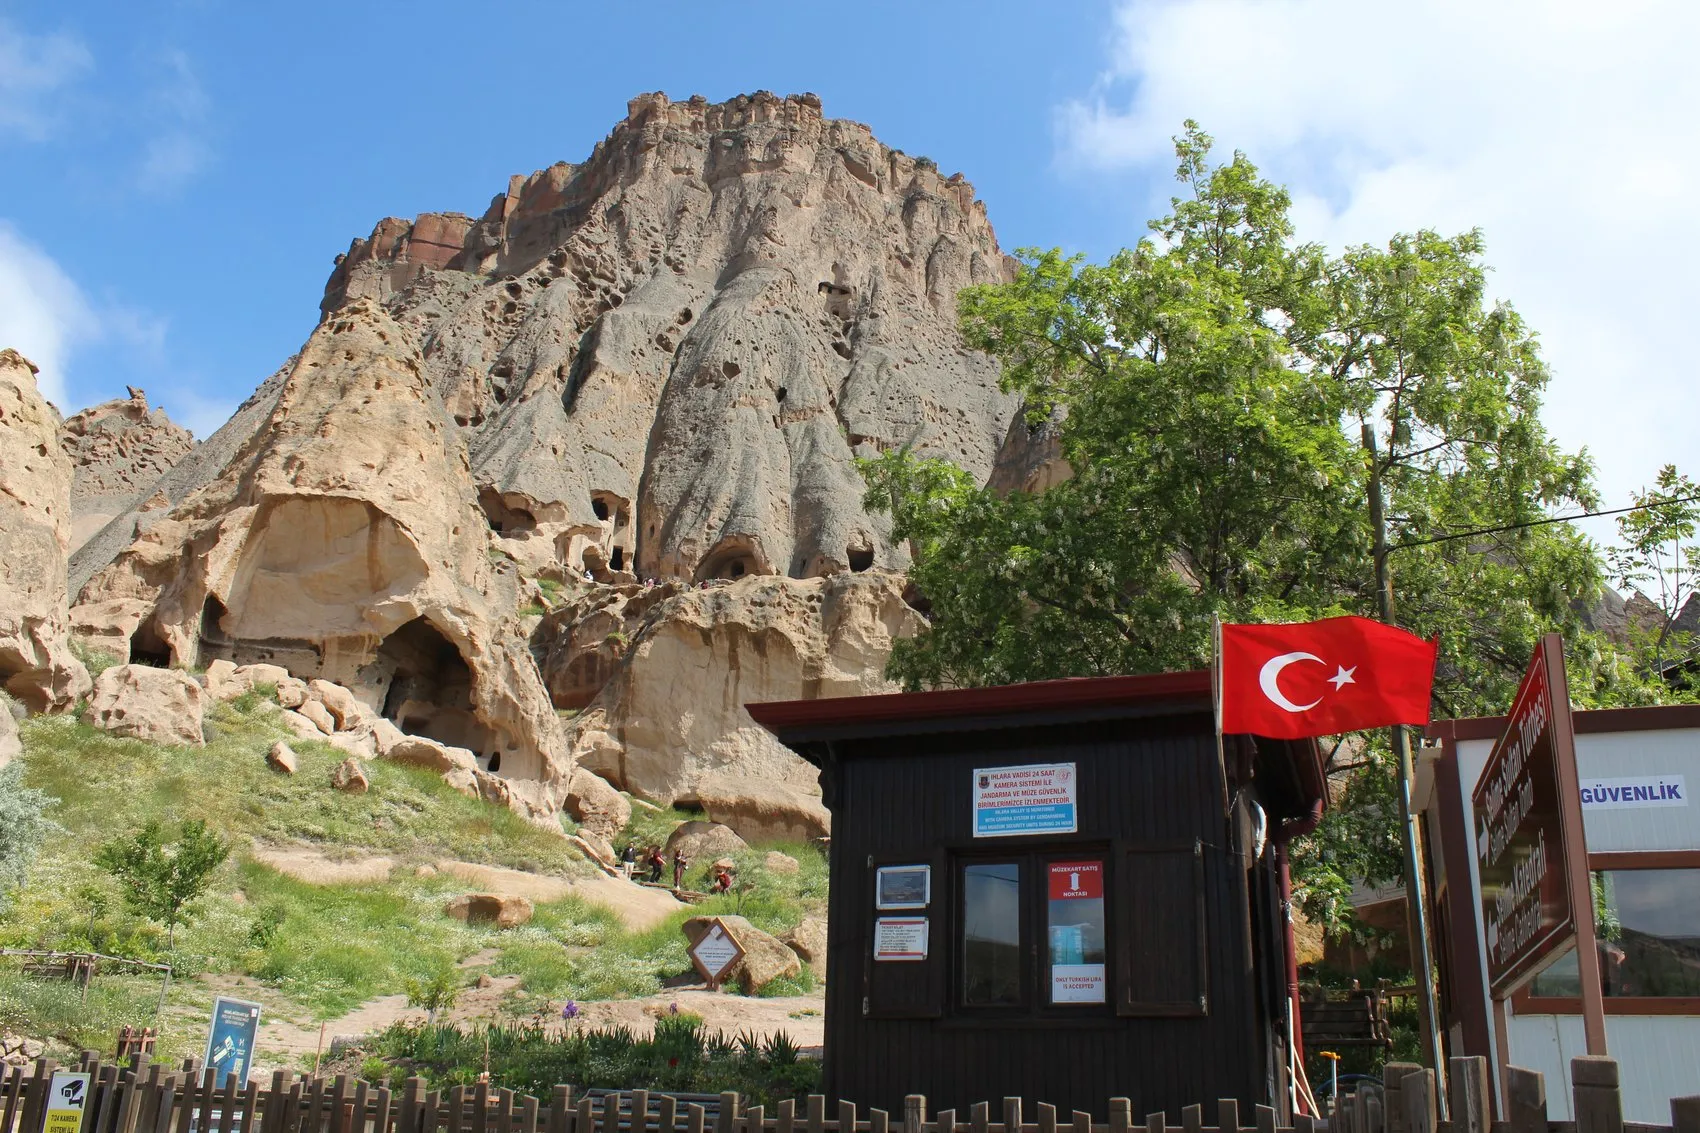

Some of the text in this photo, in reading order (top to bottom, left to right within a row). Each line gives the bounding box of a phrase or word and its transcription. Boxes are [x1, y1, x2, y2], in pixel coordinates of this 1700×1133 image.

[1501, 740, 1522, 798] Sultan
[1519, 679, 1546, 763] Türbesi
[1012, 770, 1031, 779] VADİSİ
[1019, 780, 1042, 788] SİSTEMİ
[980, 790, 1012, 800] JANDARMA
[1039, 787, 1067, 796] GÜVENLİK
[1581, 781, 1682, 803] GÜVENLİK
[1513, 828, 1547, 906] Katedrali
[1515, 888, 1543, 950] Cathedral
